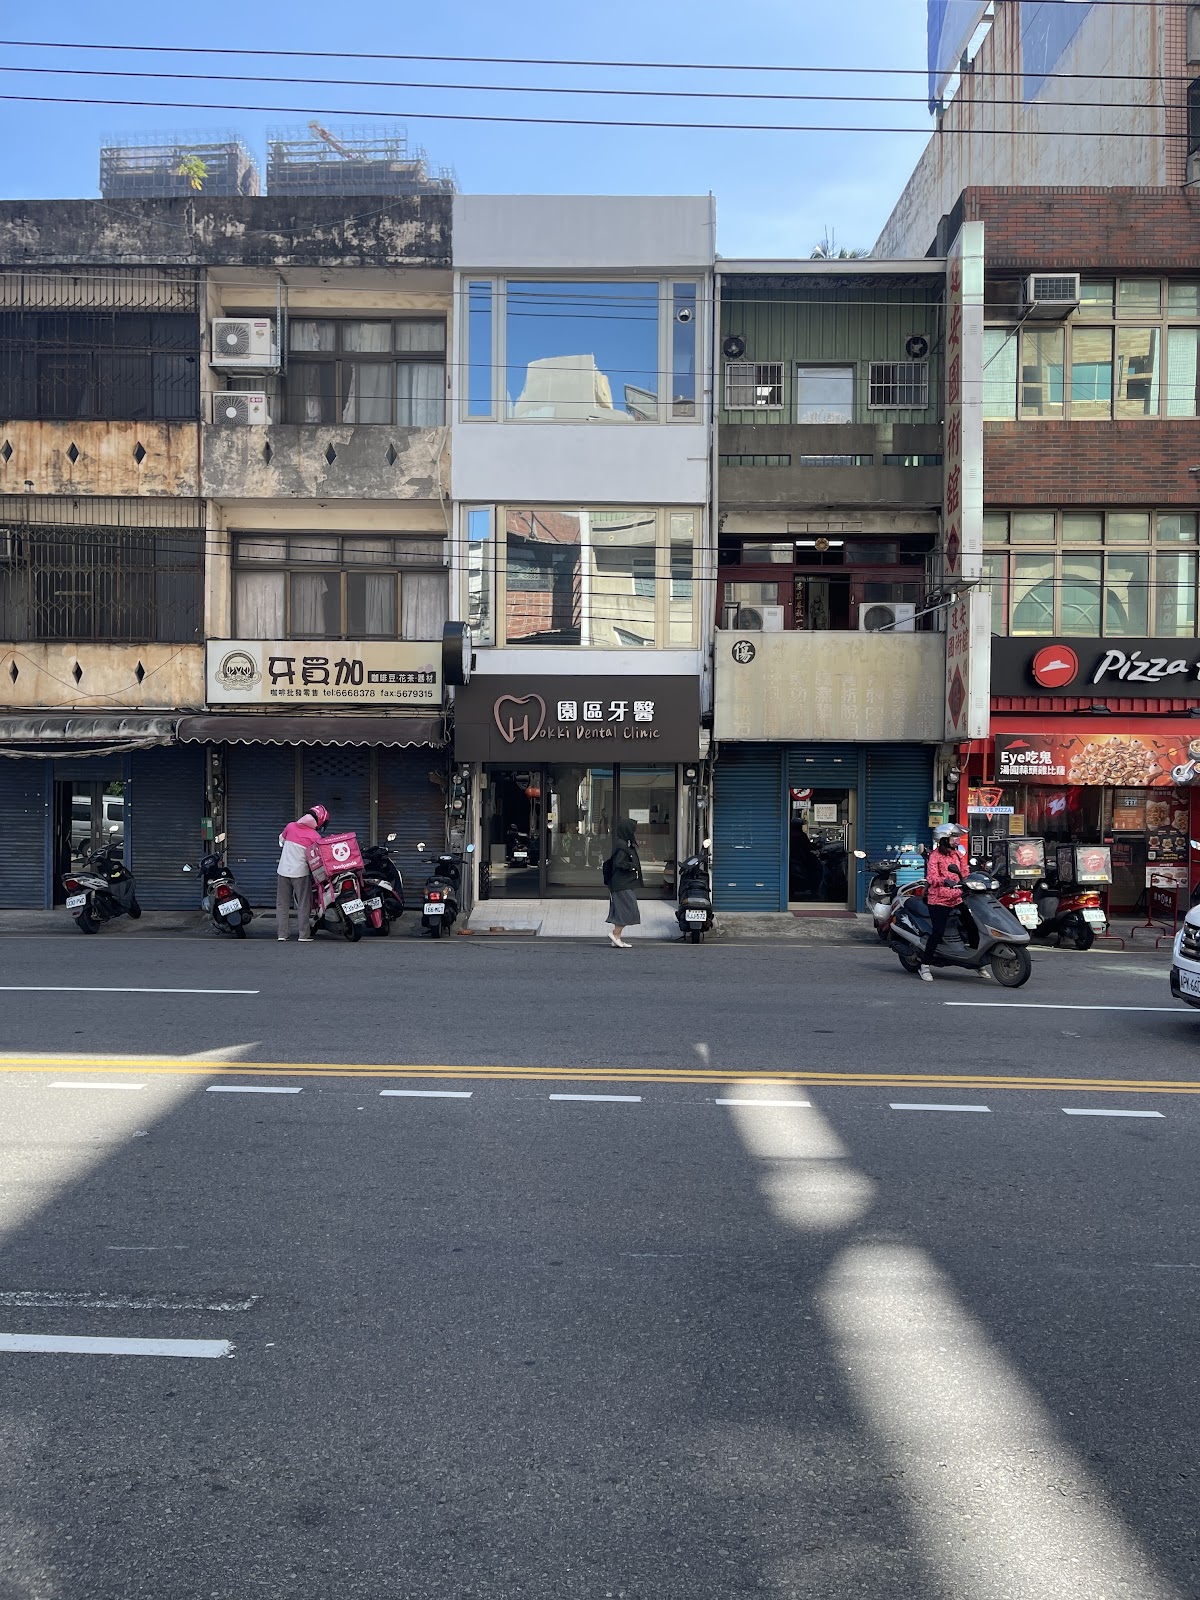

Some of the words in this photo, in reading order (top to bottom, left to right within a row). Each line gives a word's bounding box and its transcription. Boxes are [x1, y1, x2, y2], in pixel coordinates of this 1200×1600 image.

[733, 640, 755, 664] 傷
[268, 656, 364, 686] 牙買加
[1093, 649, 1189, 685] Pizza
[270, 688, 319, 697] 咖啡批發零售
[323, 689, 375, 698] tel:6668378
[380, 689, 433, 698] fax:5679315
[557, 700, 655, 722] 園區牙醫
[576, 725, 617, 740] Dental
[623, 726, 661, 740] Clinic
[1001, 751, 1052, 765] Eye吃鬼
